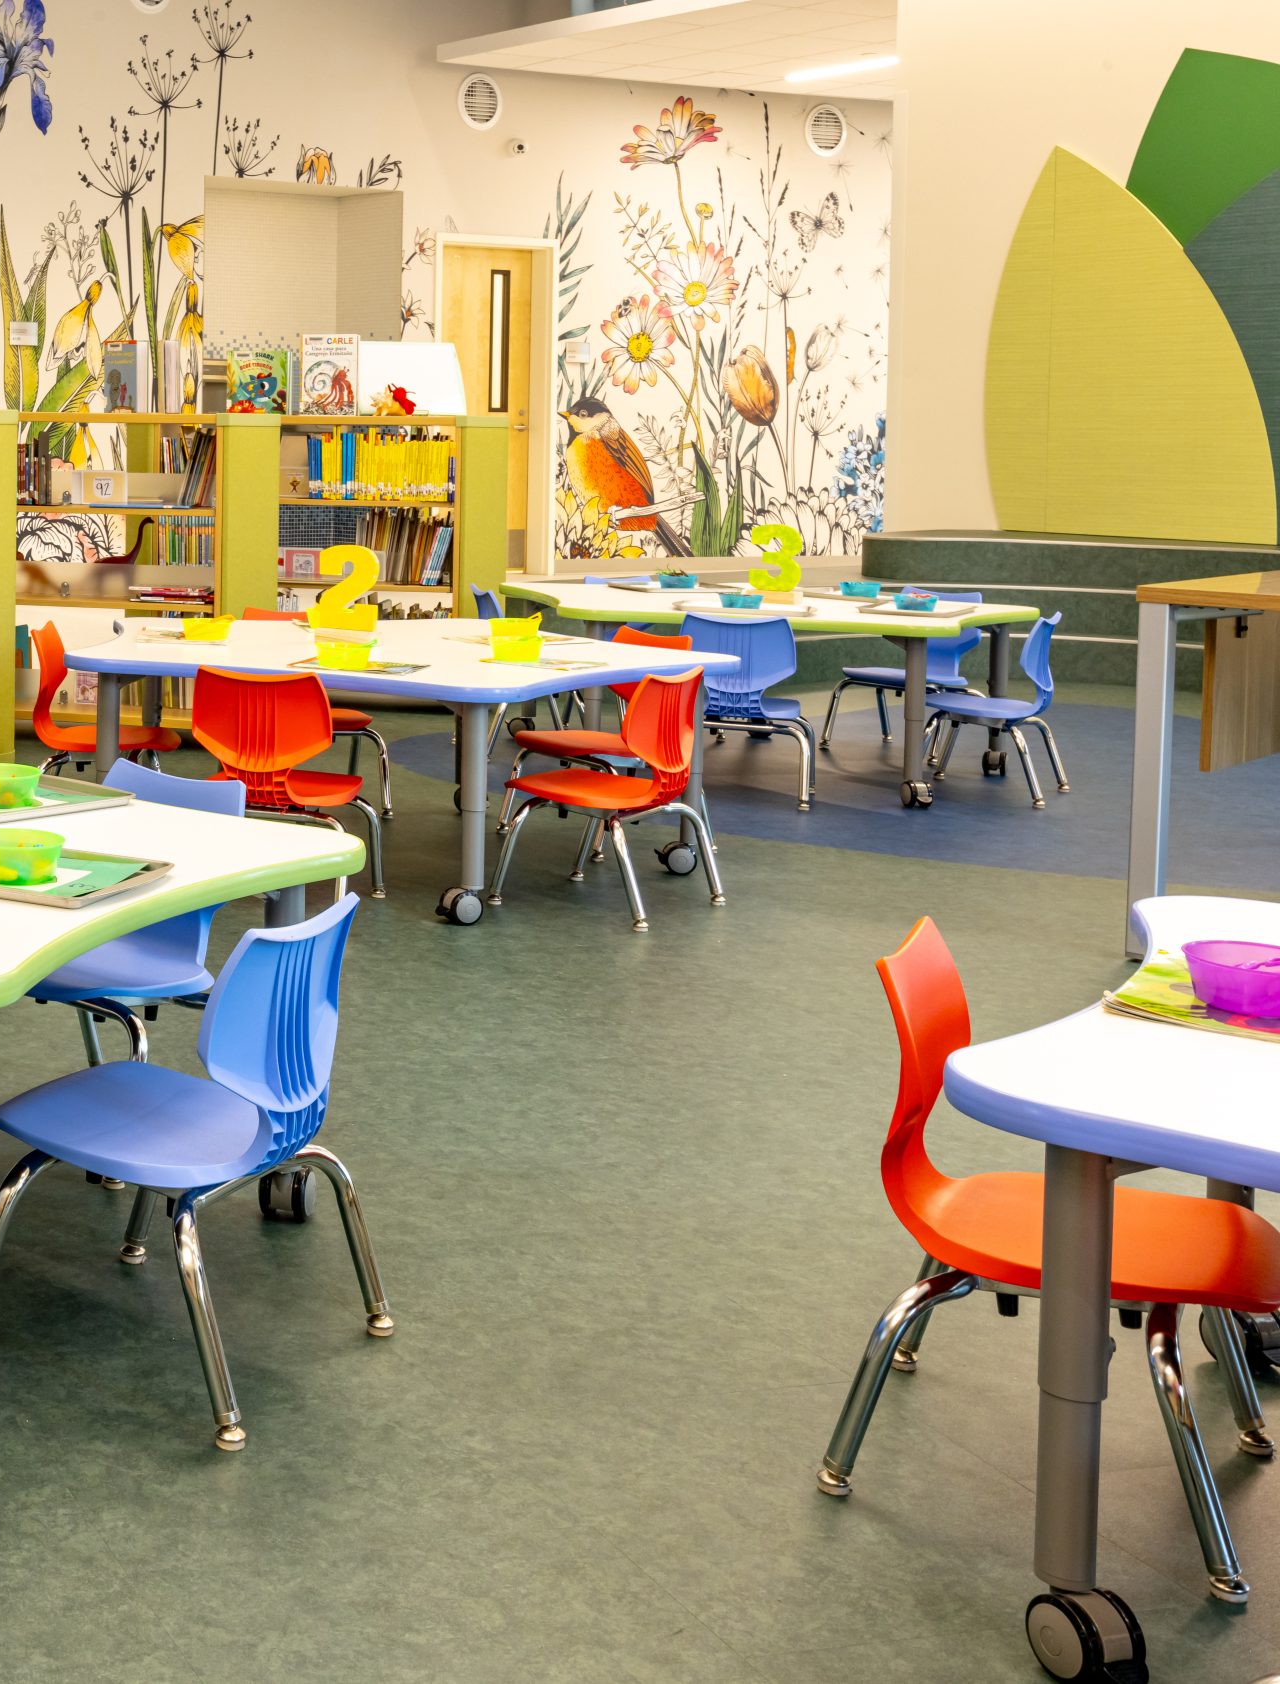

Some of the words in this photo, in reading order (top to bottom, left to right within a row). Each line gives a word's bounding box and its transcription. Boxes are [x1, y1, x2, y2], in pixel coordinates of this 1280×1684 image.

[326, 337, 353, 345] CARLE
[255, 352, 275, 361] SHARK
[95, 482, 112, 496] 92
[748, 523, 803, 593] 3
[319, 544, 380, 632] 2
